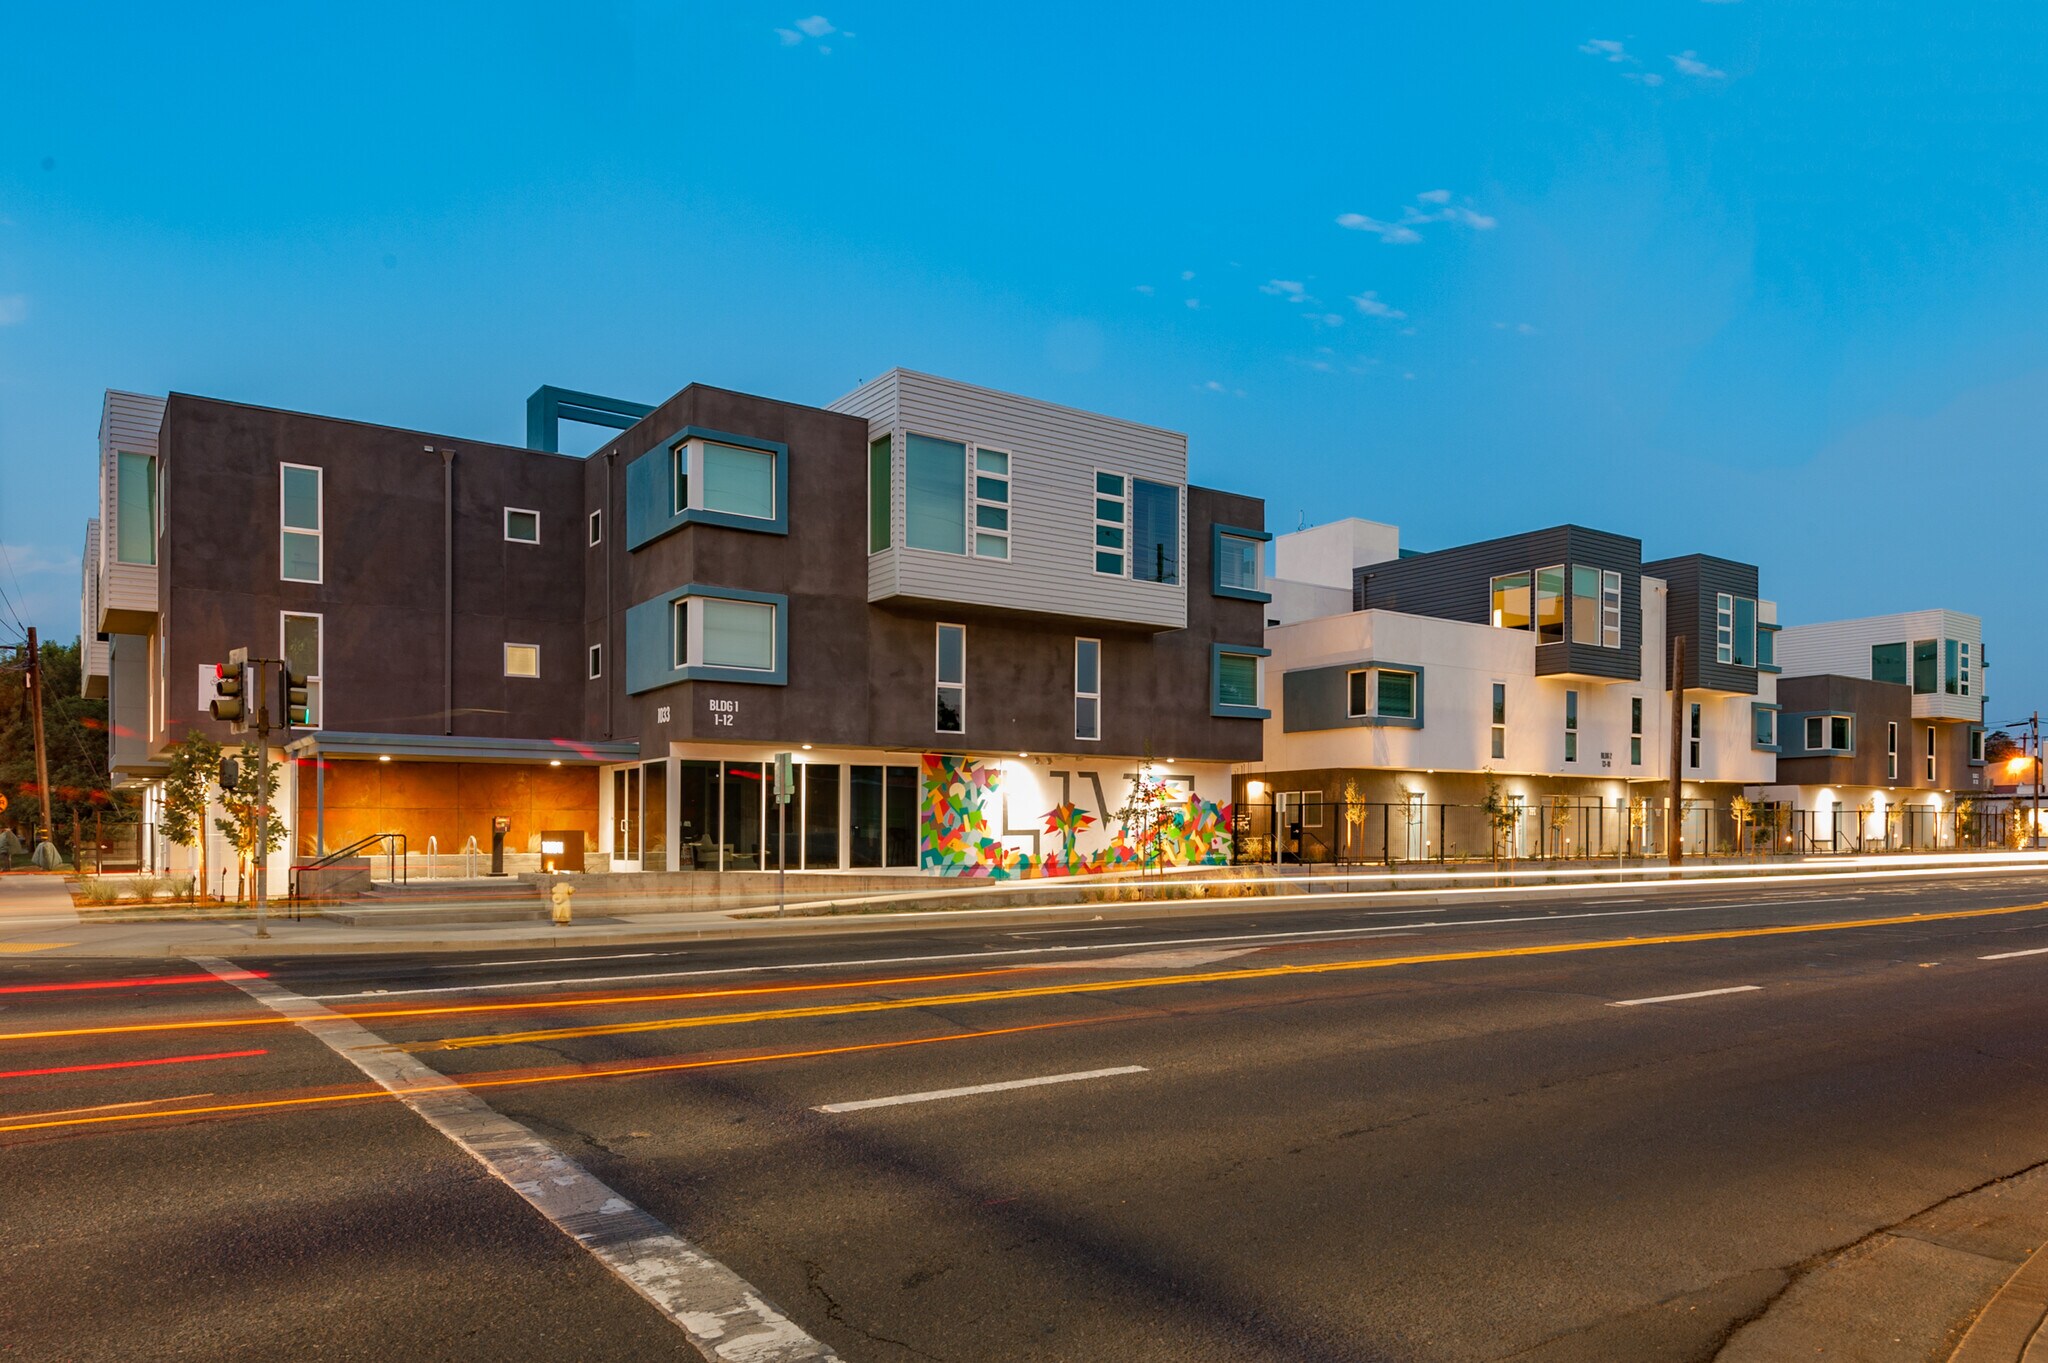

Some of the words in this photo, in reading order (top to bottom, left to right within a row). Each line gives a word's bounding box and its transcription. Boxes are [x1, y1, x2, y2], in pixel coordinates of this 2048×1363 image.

[709, 699, 733, 712] BLDG
[734, 701, 739, 712] 1
[657, 706, 671, 724] 1033
[714, 713, 734, 726] 1-12
